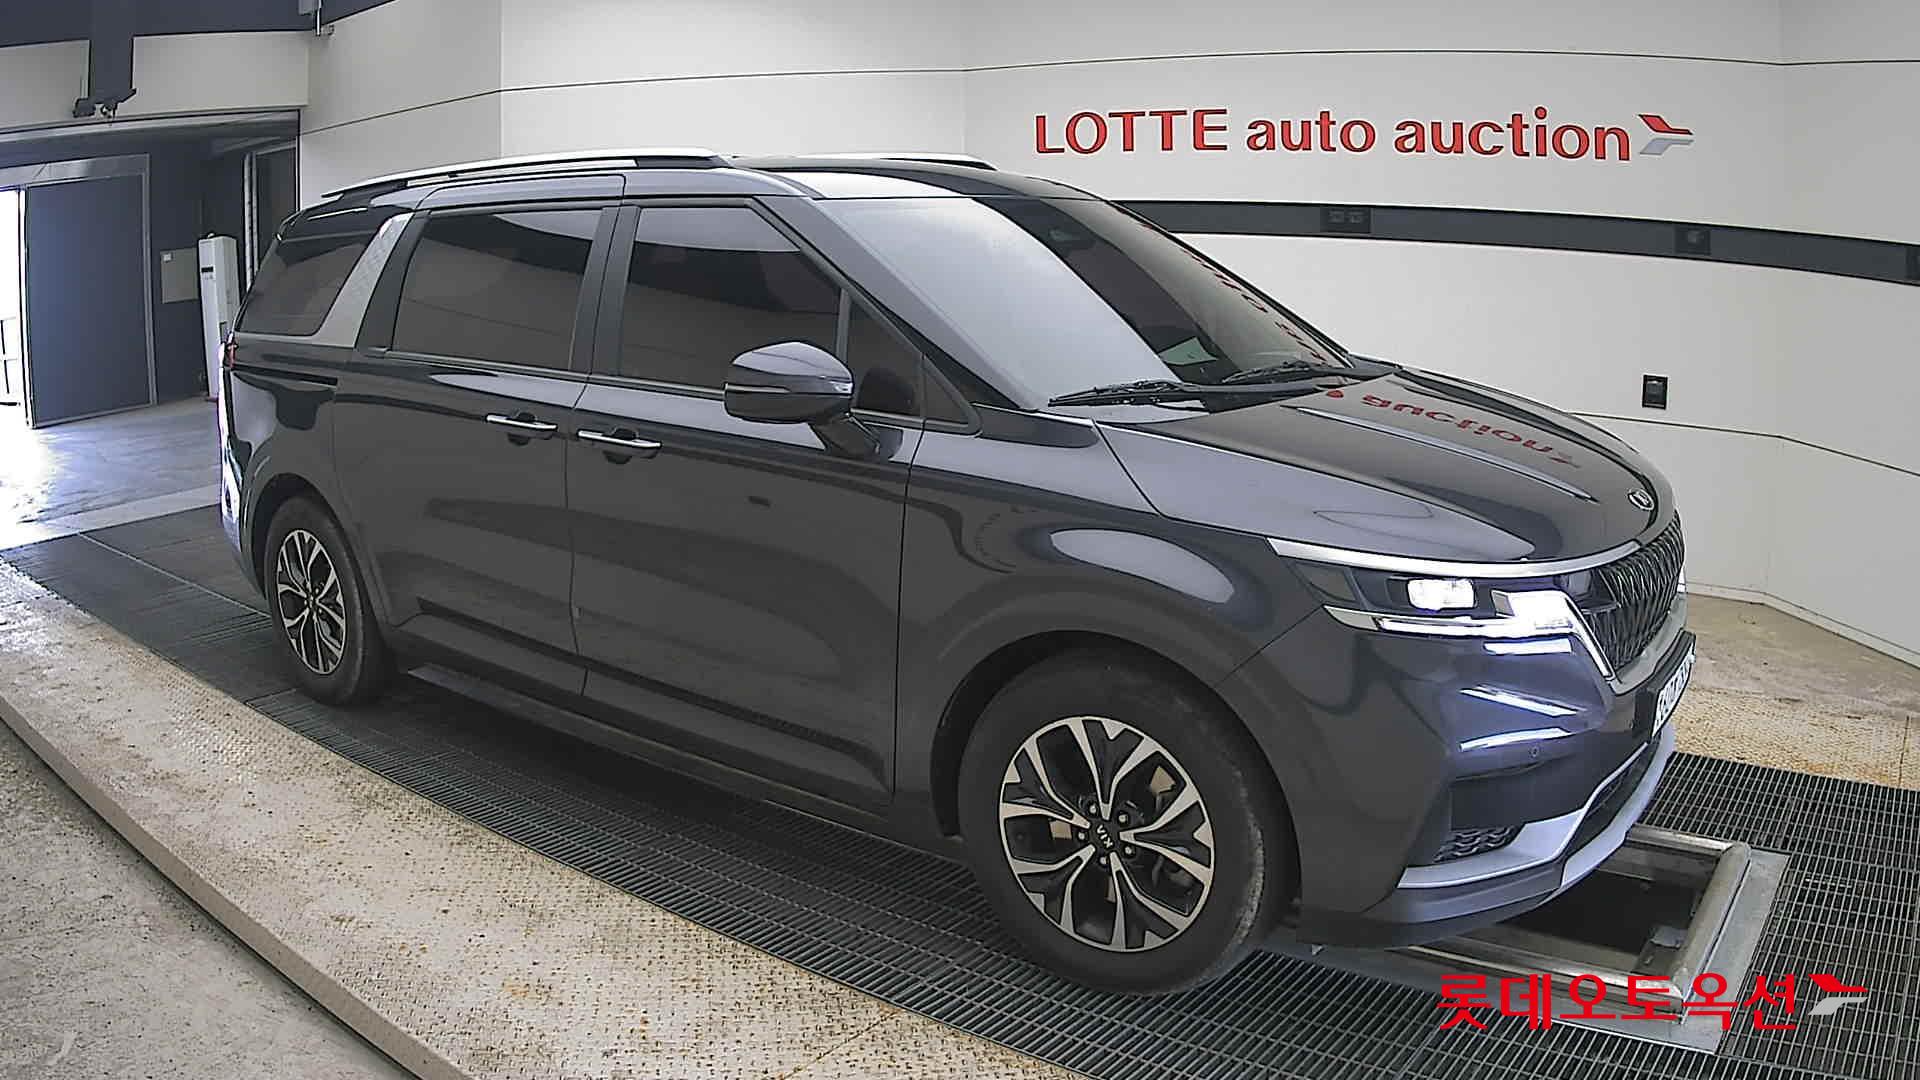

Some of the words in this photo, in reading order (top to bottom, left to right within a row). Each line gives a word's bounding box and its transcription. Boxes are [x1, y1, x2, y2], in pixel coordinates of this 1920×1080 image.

[1035, 109, 1228, 155] LOTTE
[1246, 110, 1376, 153] auto
[1394, 105, 1631, 162] auction
